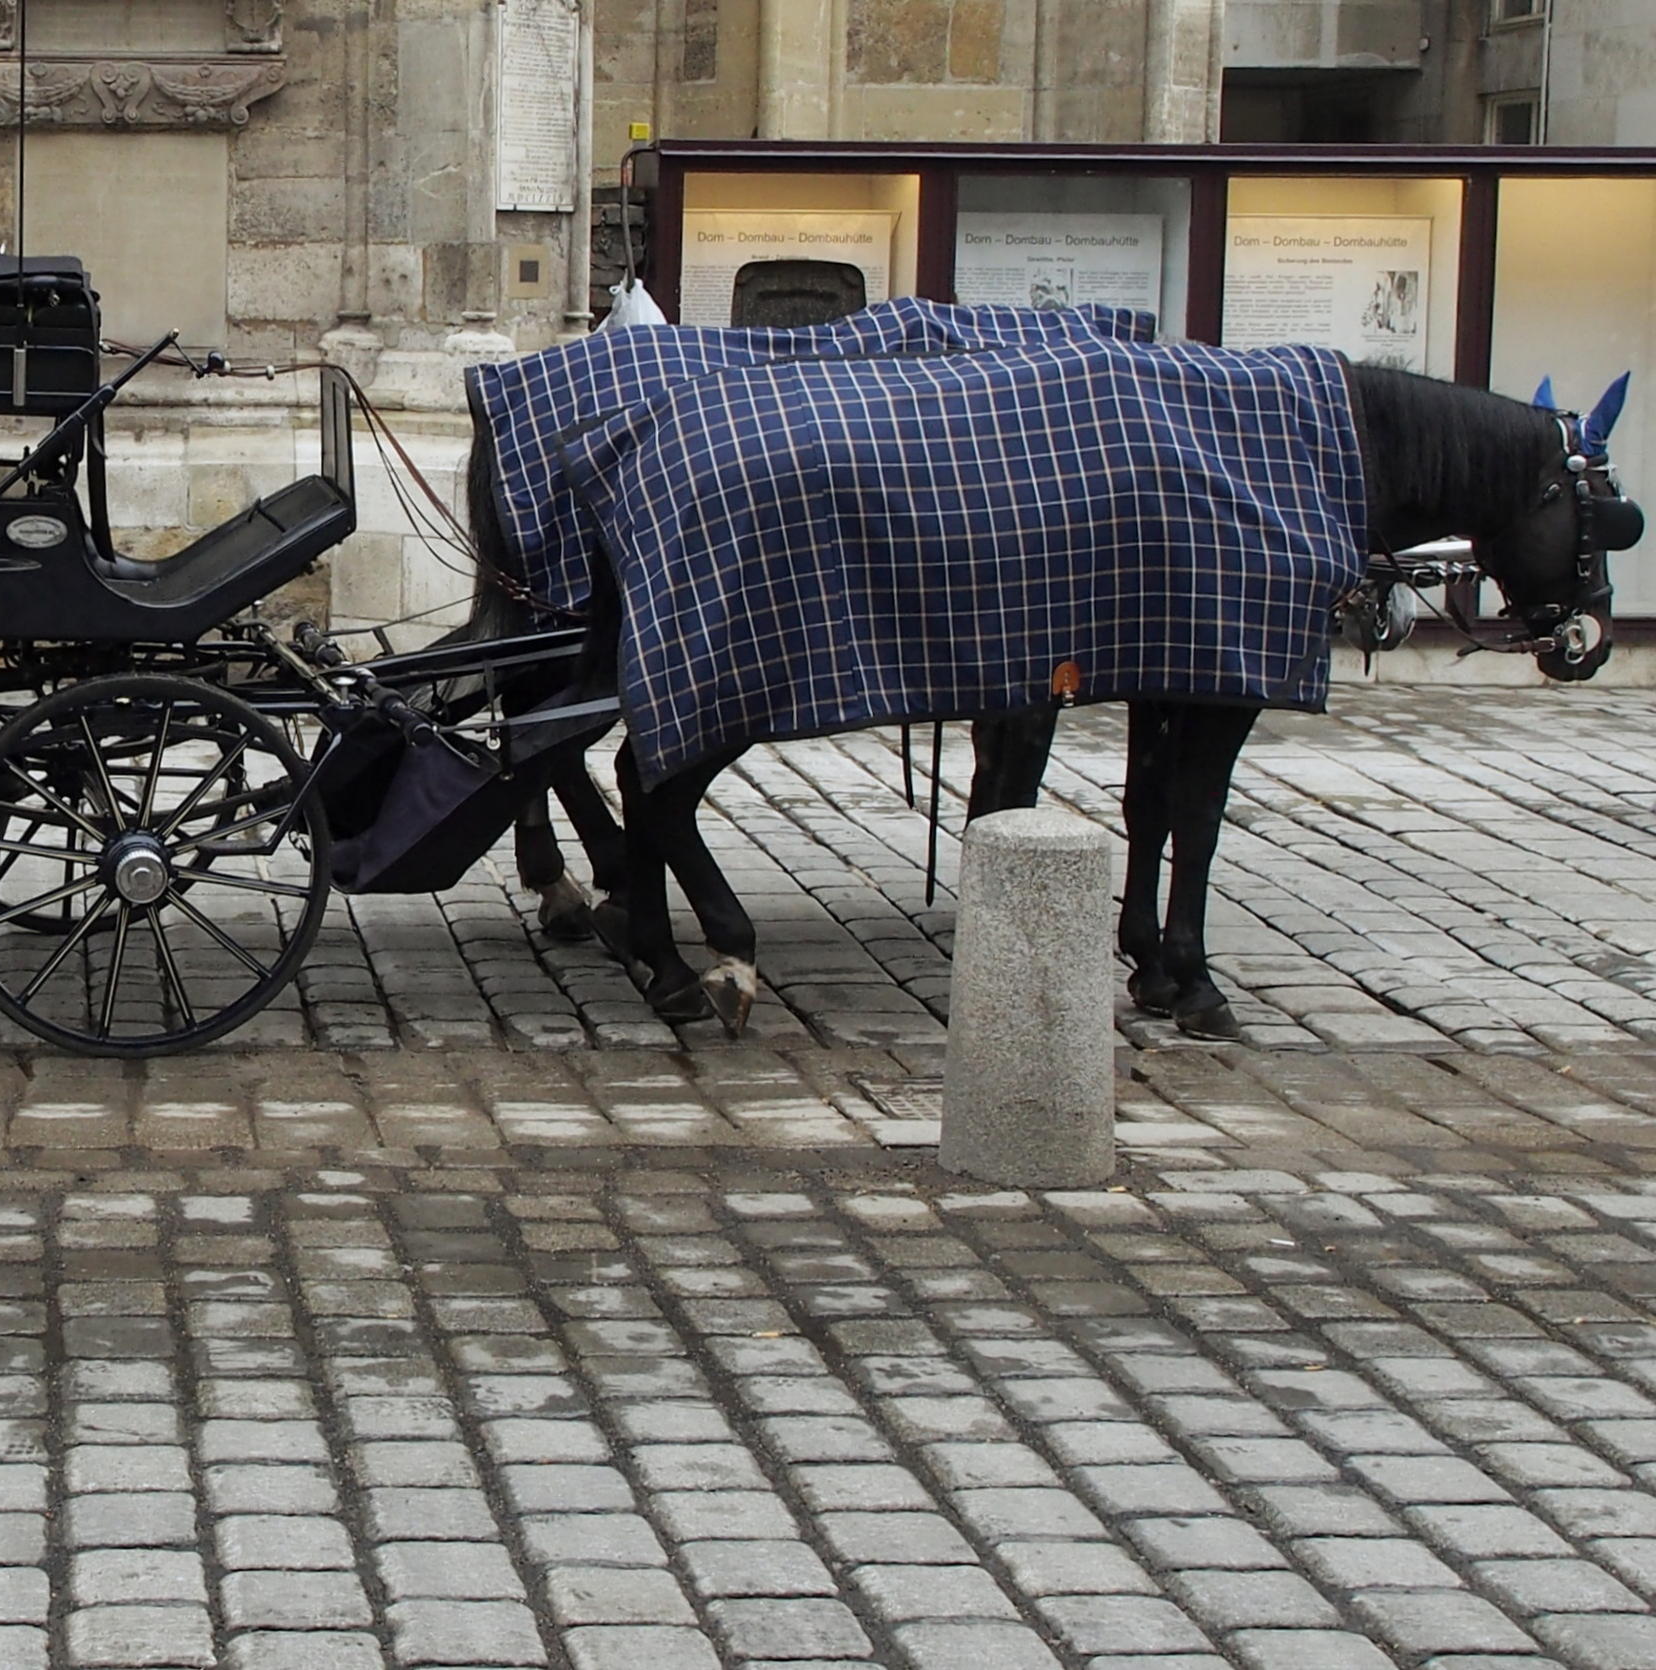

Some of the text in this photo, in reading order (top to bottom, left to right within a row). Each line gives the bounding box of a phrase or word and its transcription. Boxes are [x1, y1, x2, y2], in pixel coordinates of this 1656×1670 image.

[697, 231, 724, 242] Dom
[737, 231, 785, 243] Dombau
[798, 231, 873, 244] Dombauhütte
[964, 233, 992, 244] Dom
[1005, 234, 1052, 245] Dombau
[1065, 234, 1139, 247] Dombauhütte
[1233, 235, 1260, 247] Dom
[1273, 235, 1320, 247] Dombau
[1333, 236, 1407, 248] Dombauhütte
